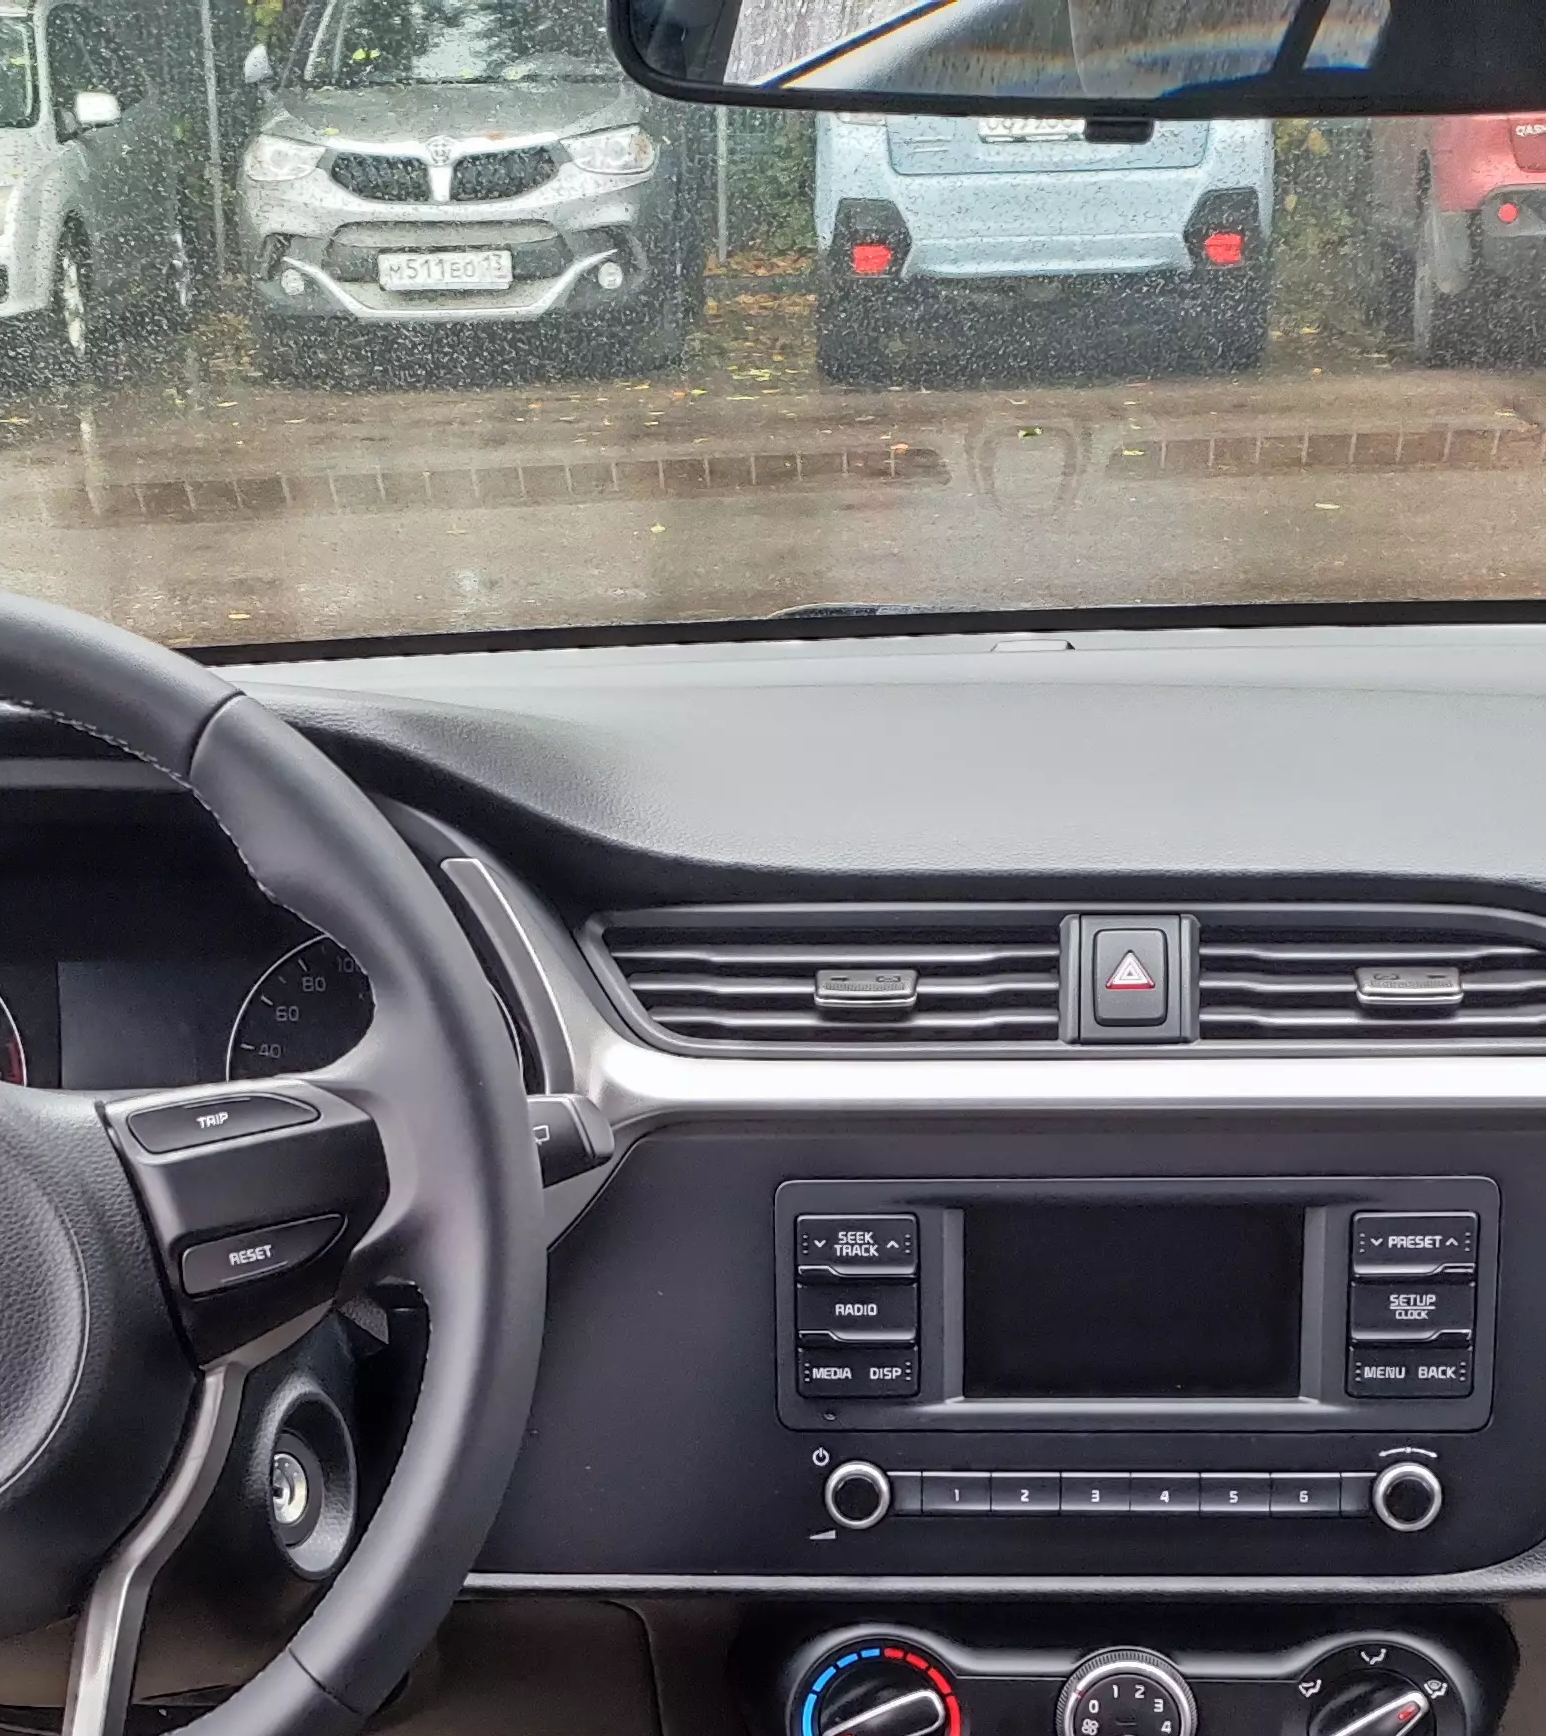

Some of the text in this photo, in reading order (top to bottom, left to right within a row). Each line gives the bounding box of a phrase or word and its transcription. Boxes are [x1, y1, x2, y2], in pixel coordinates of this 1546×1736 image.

[302, 976, 326, 993] 80
[275, 1005, 300, 1022] 60
[258, 1043, 282, 1059] 40
[196, 1111, 229, 1129] TRIP
[838, 1231, 874, 1244] SEEK
[1388, 1235, 1443, 1249] PRESET
[228, 1244, 272, 1266] RESET
[834, 1244, 879, 1257] TRACK
[1389, 1294, 1437, 1307] SETUP
[835, 1303, 878, 1316] RADIO
[1395, 1309, 1429, 1320] CLOCK
[812, 1367, 852, 1380] MEDIA
[869, 1367, 902, 1380] DISP
[1364, 1366, 1406, 1379] MENU
[1418, 1366, 1457, 1379] BACK
[954, 1488, 960, 1502] 1
[1020, 1489, 1030, 1502] 2
[1091, 1489, 1100, 1503] 3
[1159, 1490, 1170, 1503] 4
[1229, 1490, 1239, 1504] 5
[1299, 1490, 1309, 1504] 6
[1112, 1684, 1119, 1699] 1
[1134, 1684, 1145, 1699] 2
[1088, 1699, 1100, 1714] 0
[1153, 1698, 1164, 1713] 3
[1160, 1720, 1172, 1734] 4
